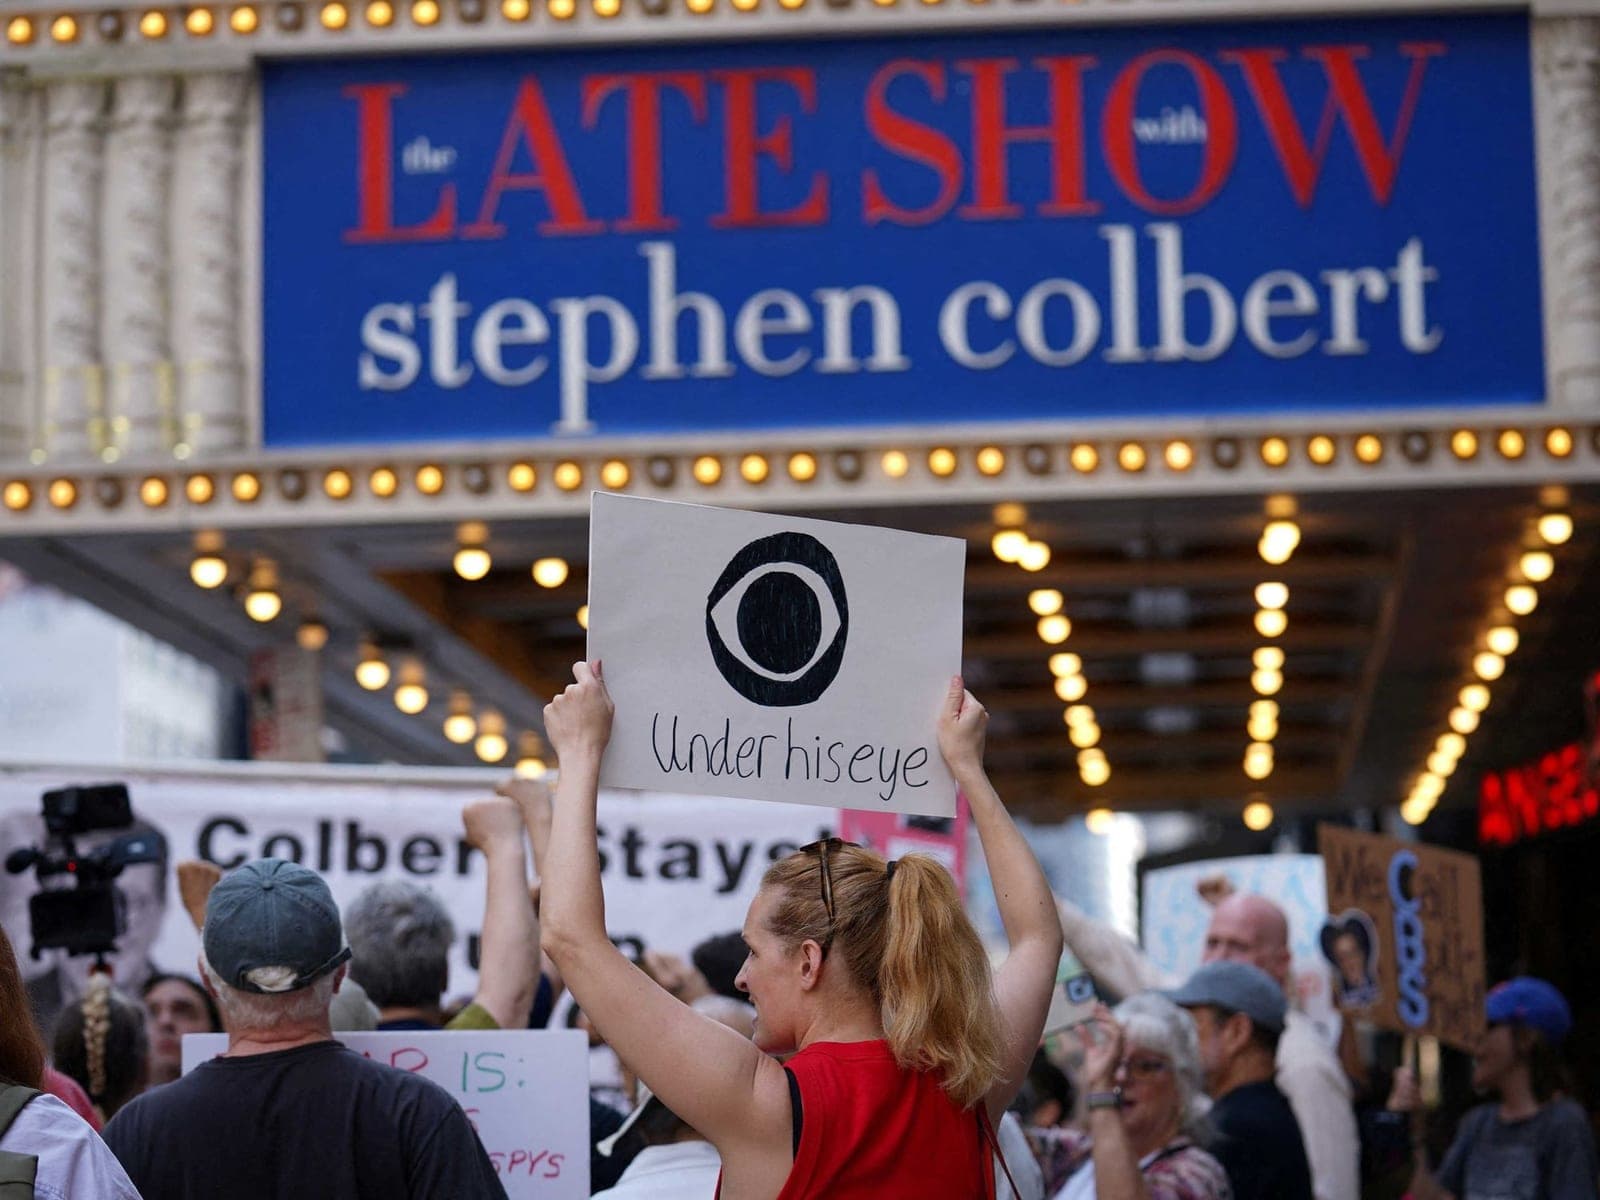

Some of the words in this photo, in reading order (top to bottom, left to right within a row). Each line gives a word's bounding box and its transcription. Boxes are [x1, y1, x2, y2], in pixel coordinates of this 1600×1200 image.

[344, 67, 828, 243] LATE
[862, 42, 1444, 223] SHOW
[402, 138, 454, 172] the
[1132, 107, 1208, 143] with
[359, 241, 909, 435] stephen
[938, 222, 1443, 369] colbert
[197, 814, 484, 877] Colber
